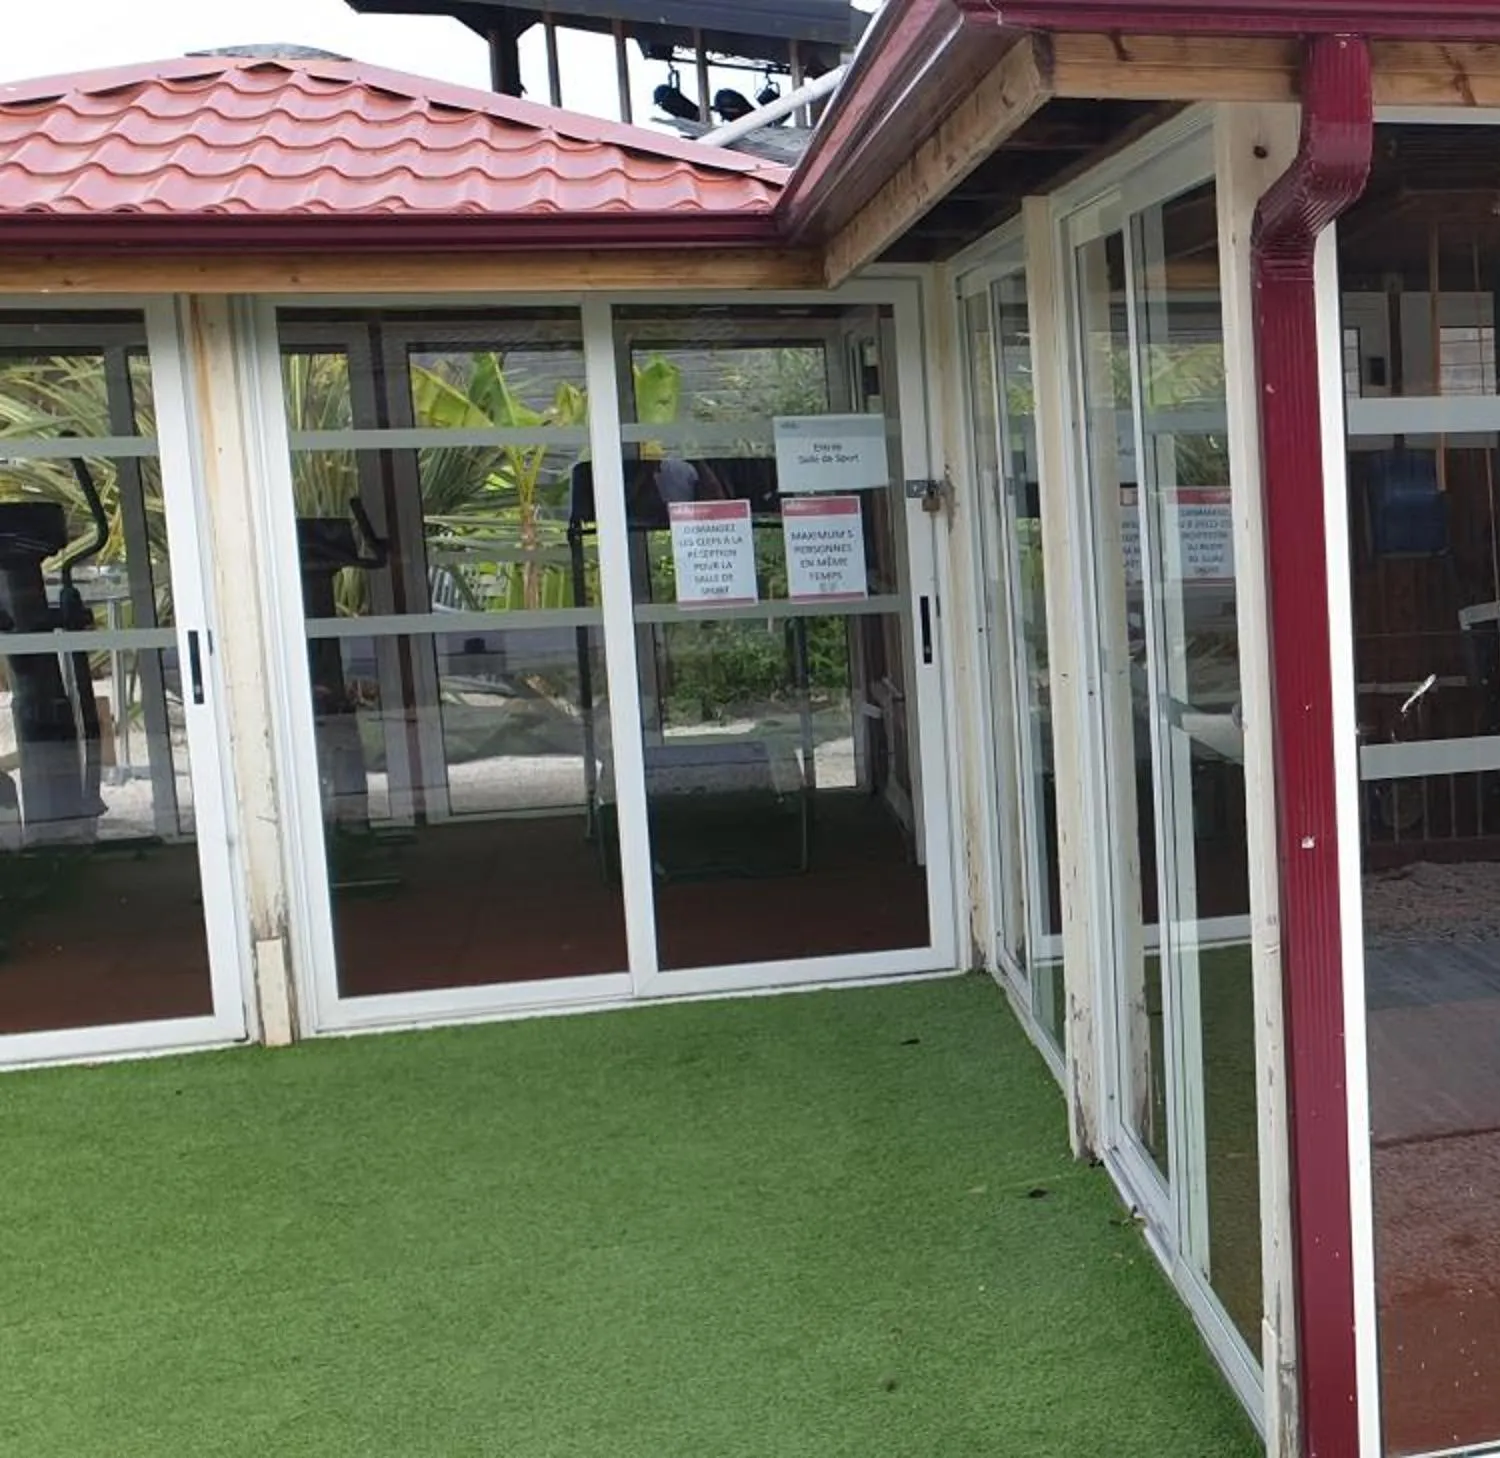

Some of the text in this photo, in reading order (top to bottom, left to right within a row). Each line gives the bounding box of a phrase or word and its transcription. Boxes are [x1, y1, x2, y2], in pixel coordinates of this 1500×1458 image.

[835, 454, 859, 464] Sport
[790, 530, 845, 540] MAXIMUM
[794, 543, 852, 554] PERSONNES
[800, 559, 814, 569] EN
[722, 573, 733, 582] DE
[809, 571, 843, 582] TEMPS
